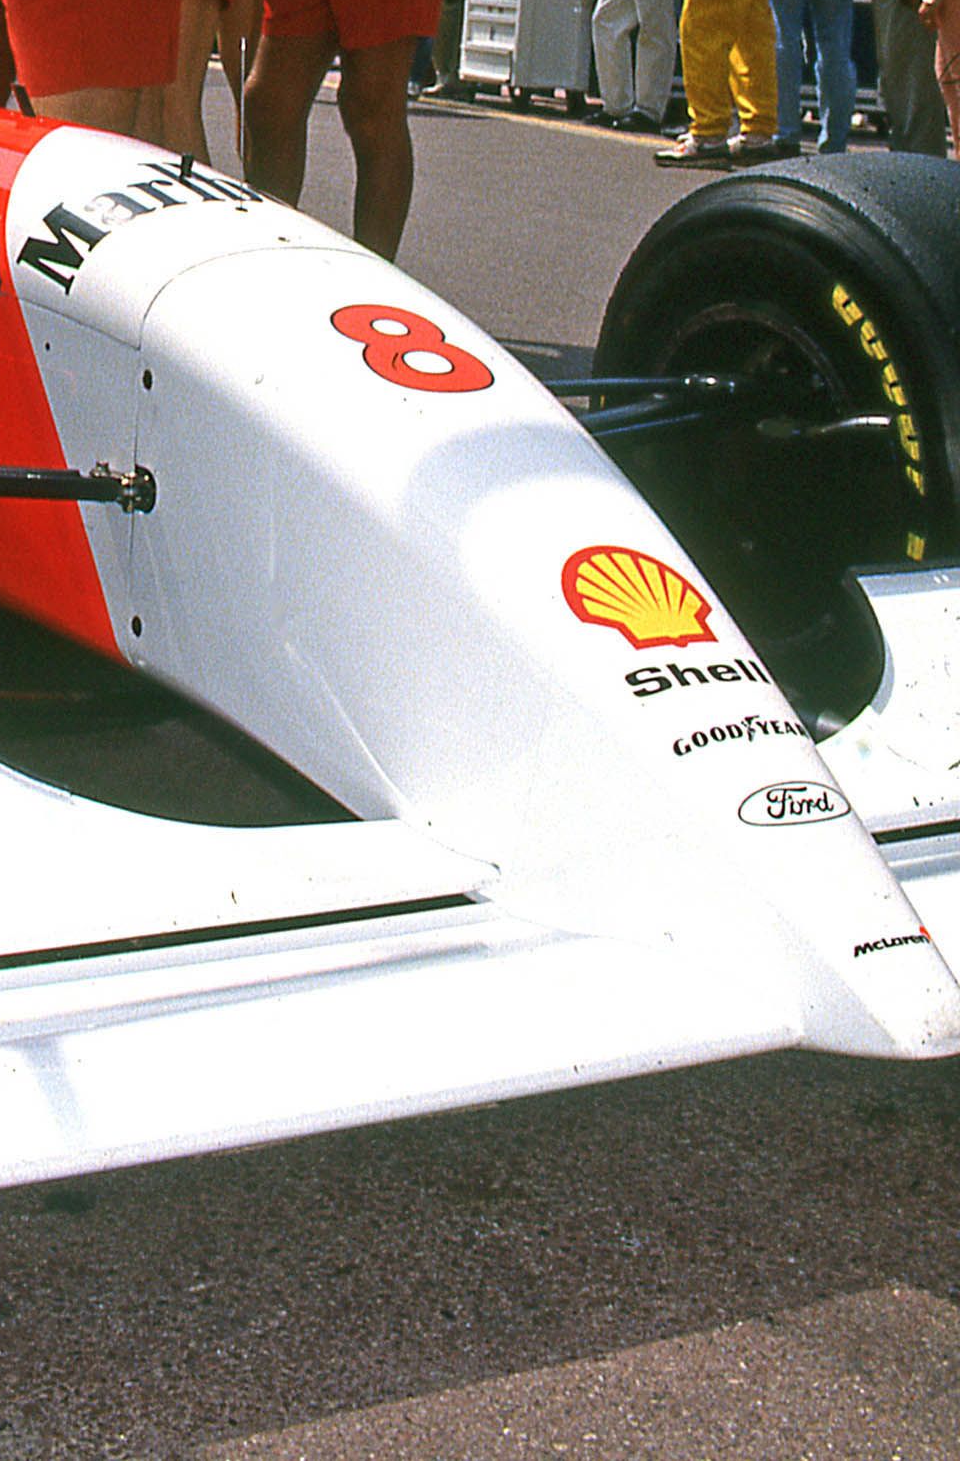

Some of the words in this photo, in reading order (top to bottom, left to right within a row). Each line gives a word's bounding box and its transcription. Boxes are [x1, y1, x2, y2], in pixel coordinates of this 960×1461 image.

[16, 160, 264, 296] Marlb
[330, 303, 495, 393] 8
[624, 659, 773, 698] Shell
[766, 786, 836, 820] Ford
[853, 934, 931, 958] McLaren
